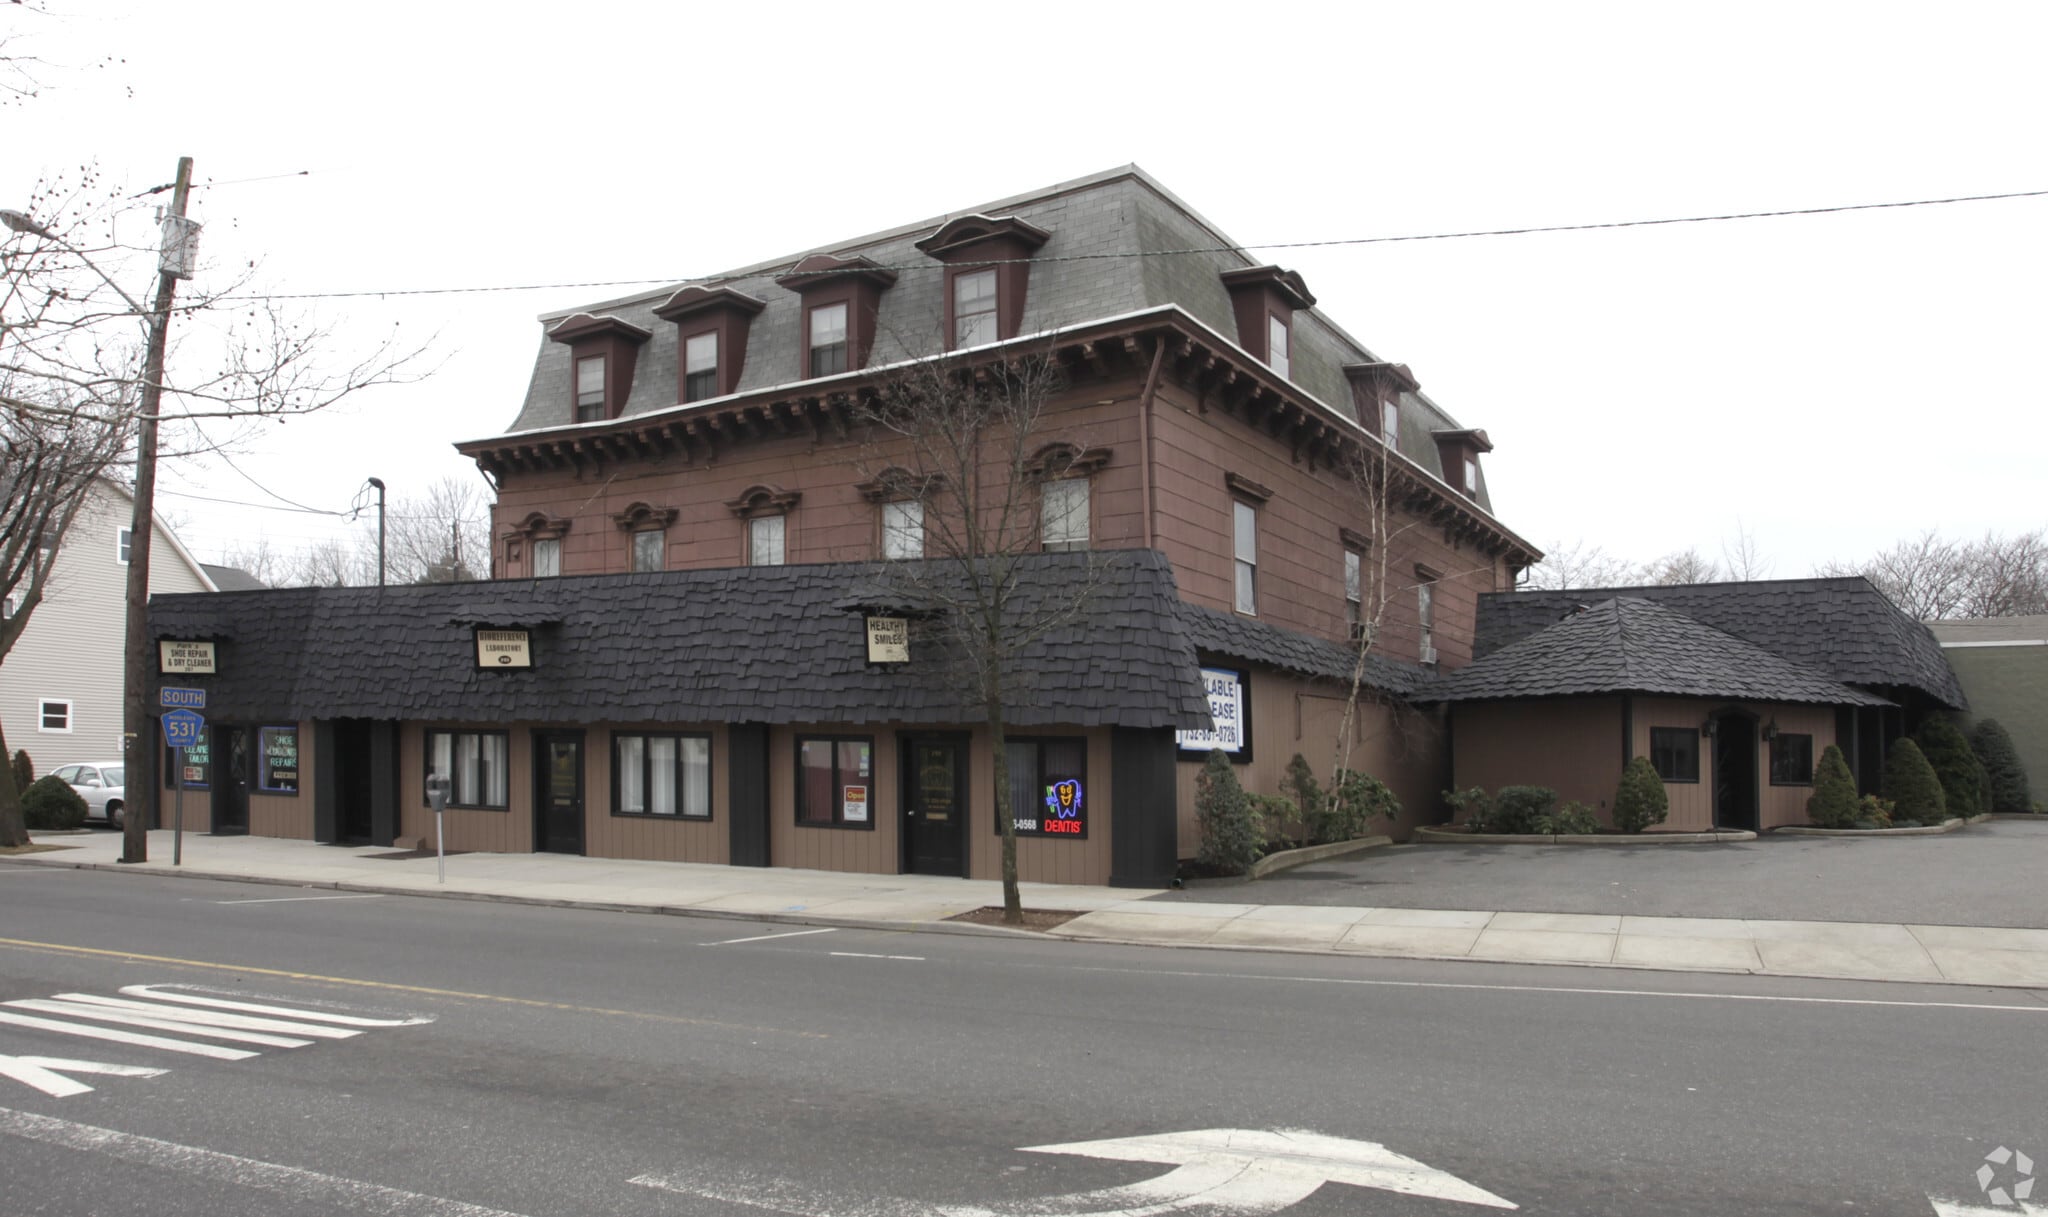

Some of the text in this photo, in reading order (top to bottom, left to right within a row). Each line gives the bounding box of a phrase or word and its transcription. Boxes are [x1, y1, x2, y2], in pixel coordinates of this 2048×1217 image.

[870, 620, 905, 632] HEALTHY
[874, 634, 903, 645] SMILES
[171, 649, 208, 658] SHOE REPAIR
[174, 658, 185, 667] DRY
[187, 658, 212, 668] CLEANER
[1202, 678, 1234, 697] LABLE
[164, 691, 203, 705] SOUTH
[1211, 702, 1235, 720] EASE
[169, 722, 196, 737] 531
